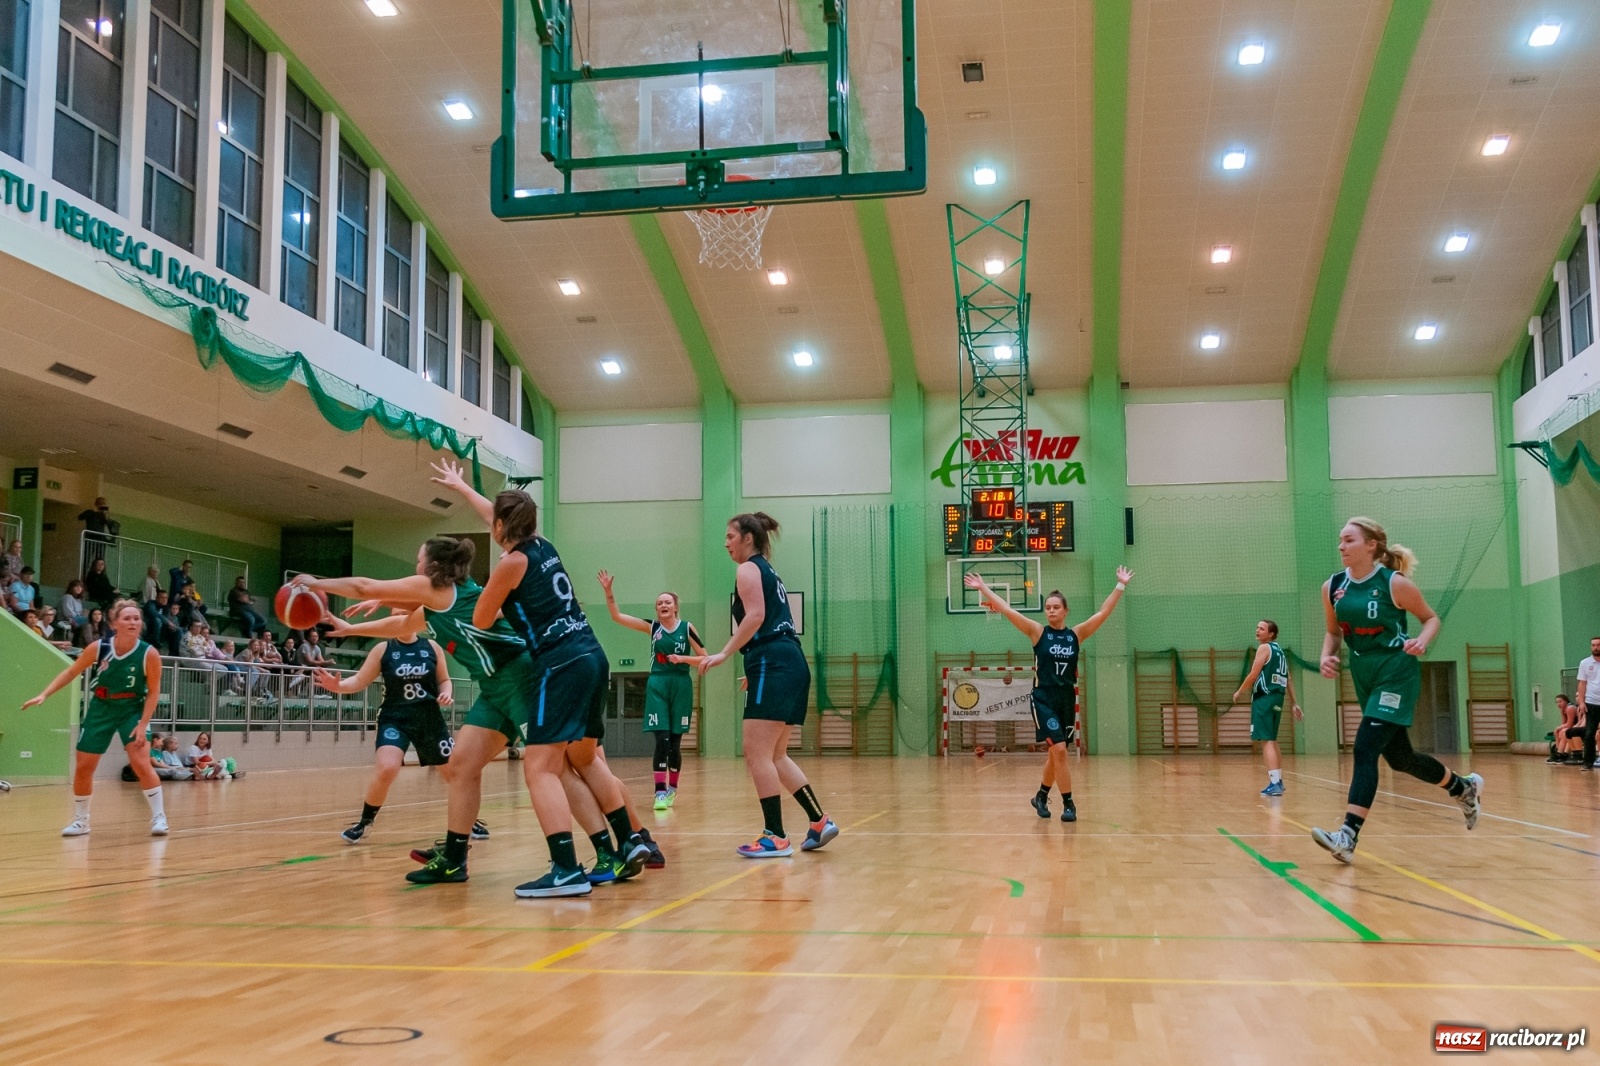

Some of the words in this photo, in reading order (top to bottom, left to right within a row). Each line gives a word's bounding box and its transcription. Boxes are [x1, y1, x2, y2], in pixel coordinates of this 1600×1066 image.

[0, 169, 35, 213] TU
[40, 190, 48, 222] I
[55, 198, 163, 279] REKREACJI
[168, 257, 250, 321] RACIBÓRZ
[20, 475, 33, 487] F
[988, 503, 1004, 517] 10
[1030, 537, 1047, 549] 48
[553, 571, 573, 612] 9
[1367, 600, 1378, 619] 8
[674, 642, 686, 653] 24
[1054, 662, 1068, 676] 17
[126, 675, 136, 688] 3
[403, 682, 428, 700] 88
[984, 702, 1004, 714] JEST
[1005, 699, 1014, 707] W
[648, 713, 659, 726] 24
